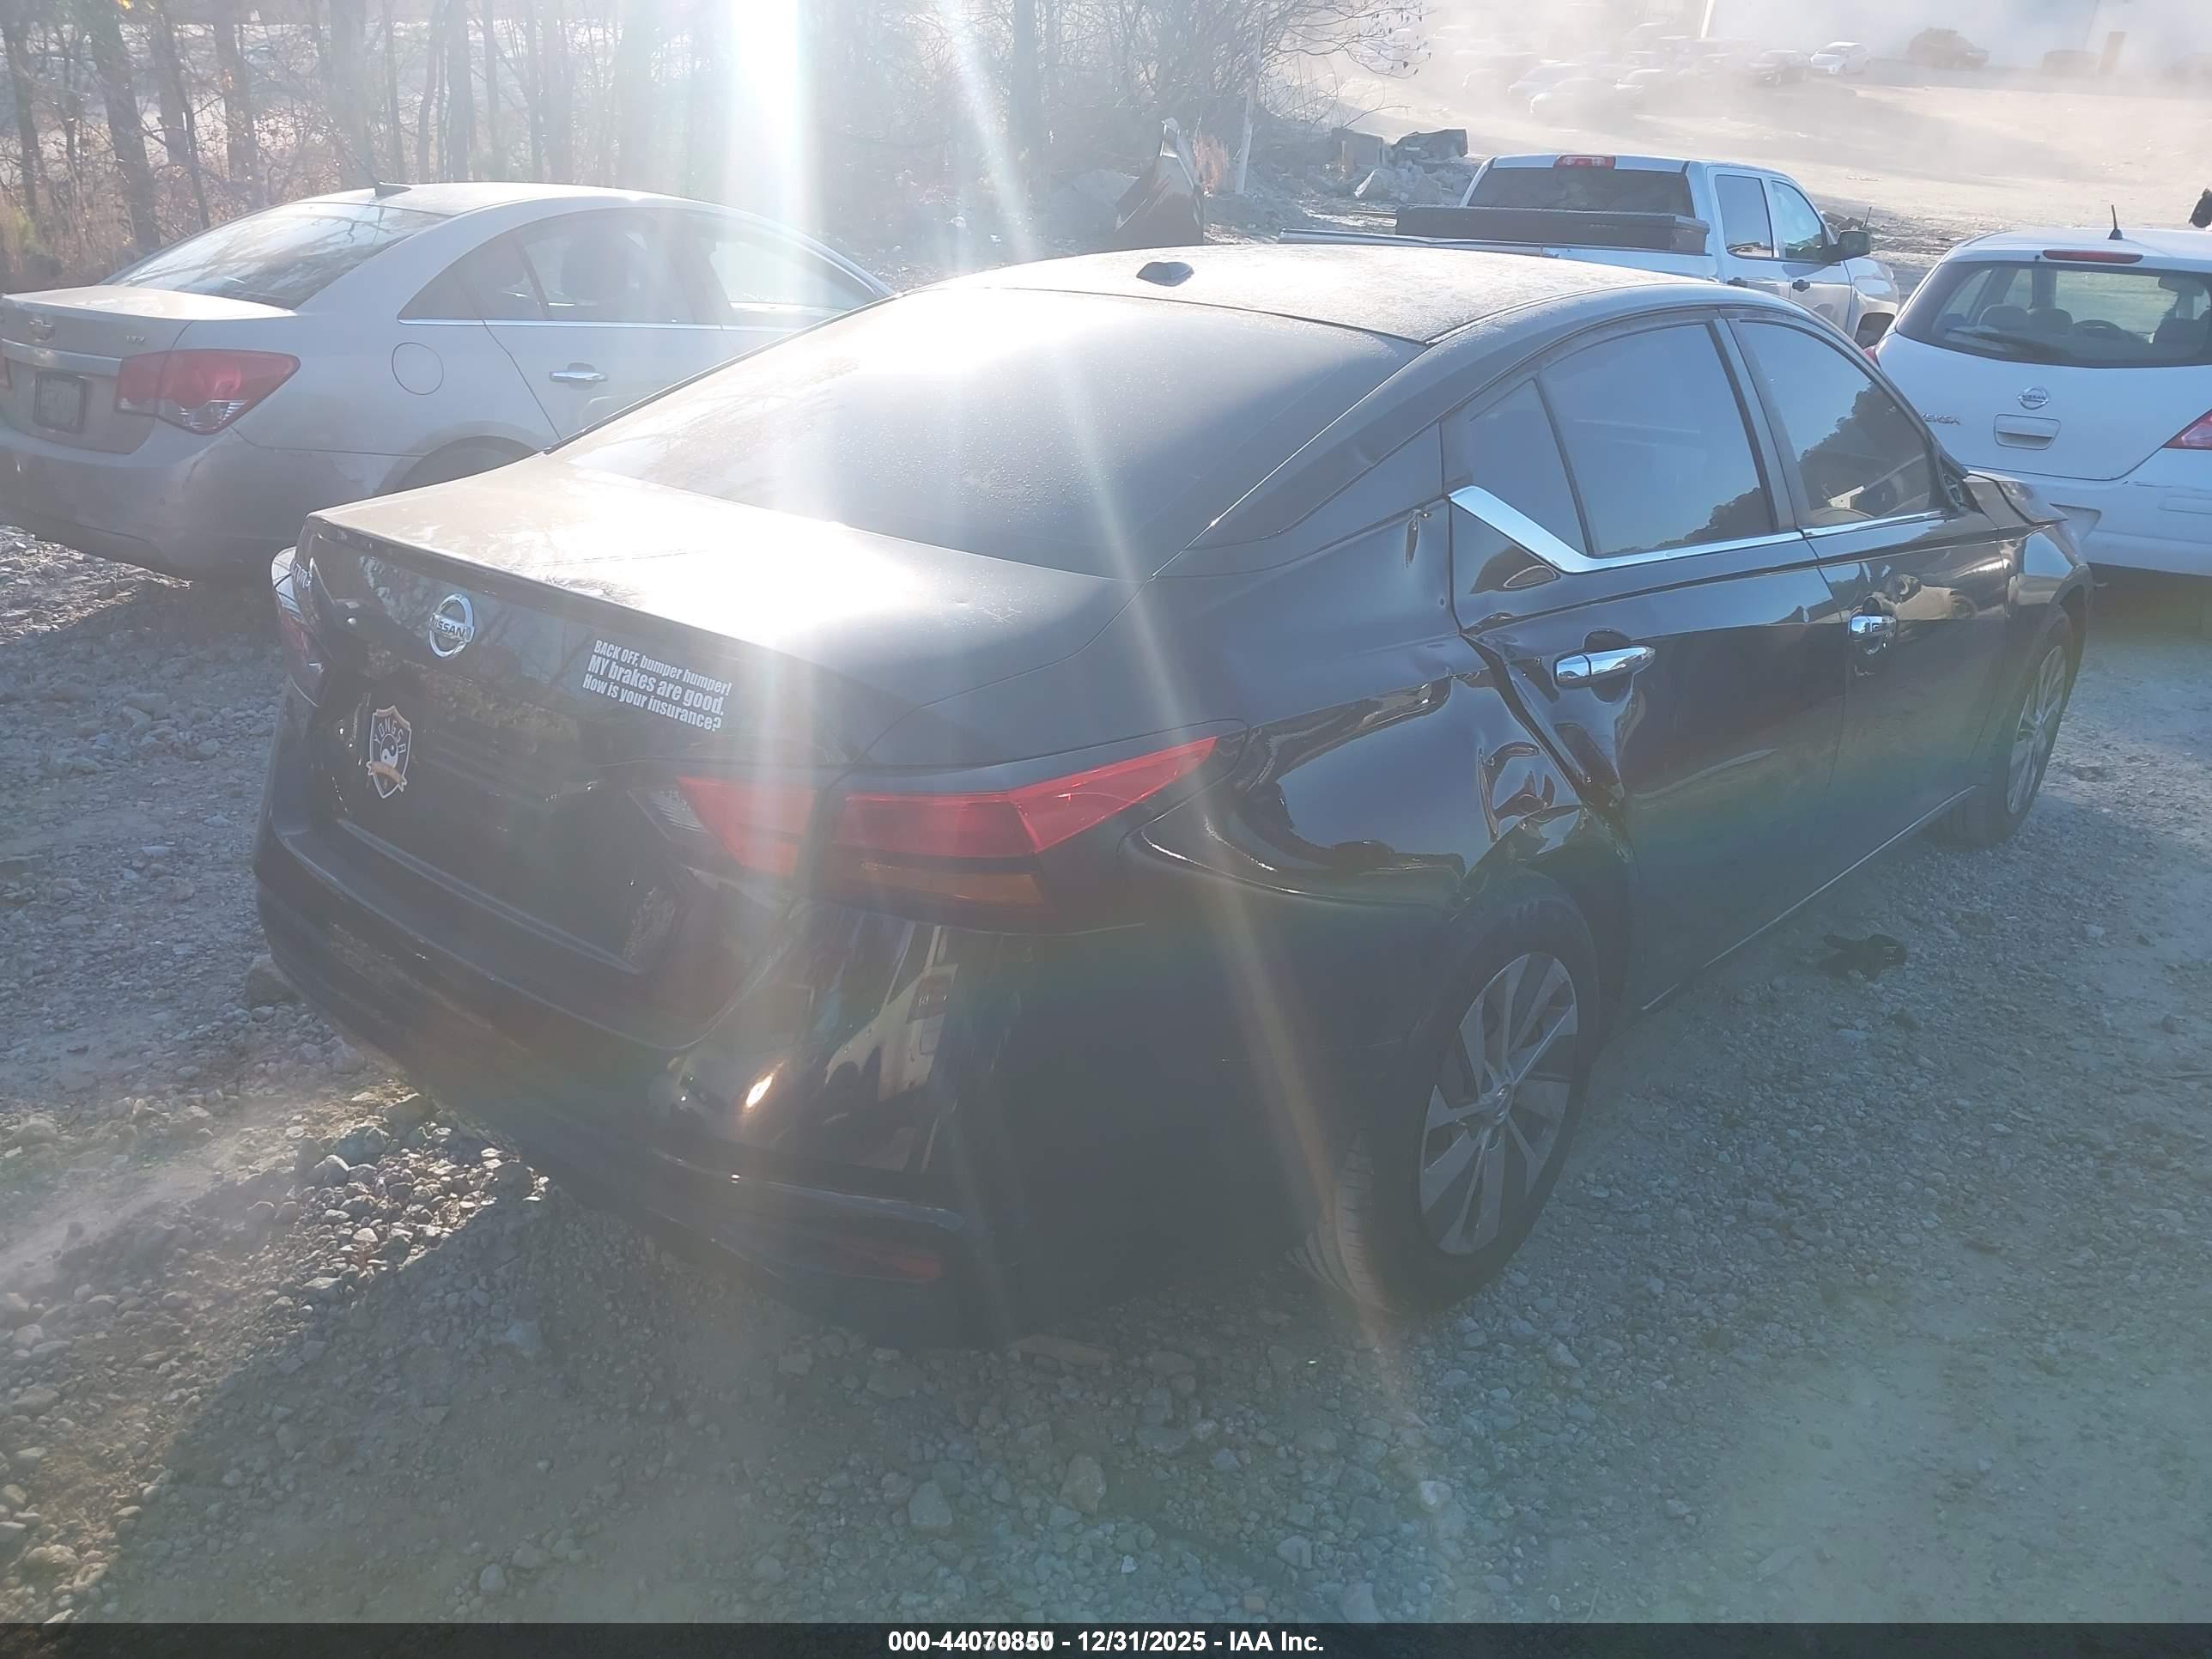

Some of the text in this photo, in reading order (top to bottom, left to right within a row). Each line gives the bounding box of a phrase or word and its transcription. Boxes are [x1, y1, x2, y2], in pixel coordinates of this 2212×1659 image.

[432, 617, 465, 637] NISSAN
[587, 654, 724, 716] MY brakes are good.
[593, 639, 732, 696] BACK OFF, bumper humper!
[582, 673, 722, 732] How is your insurance?
